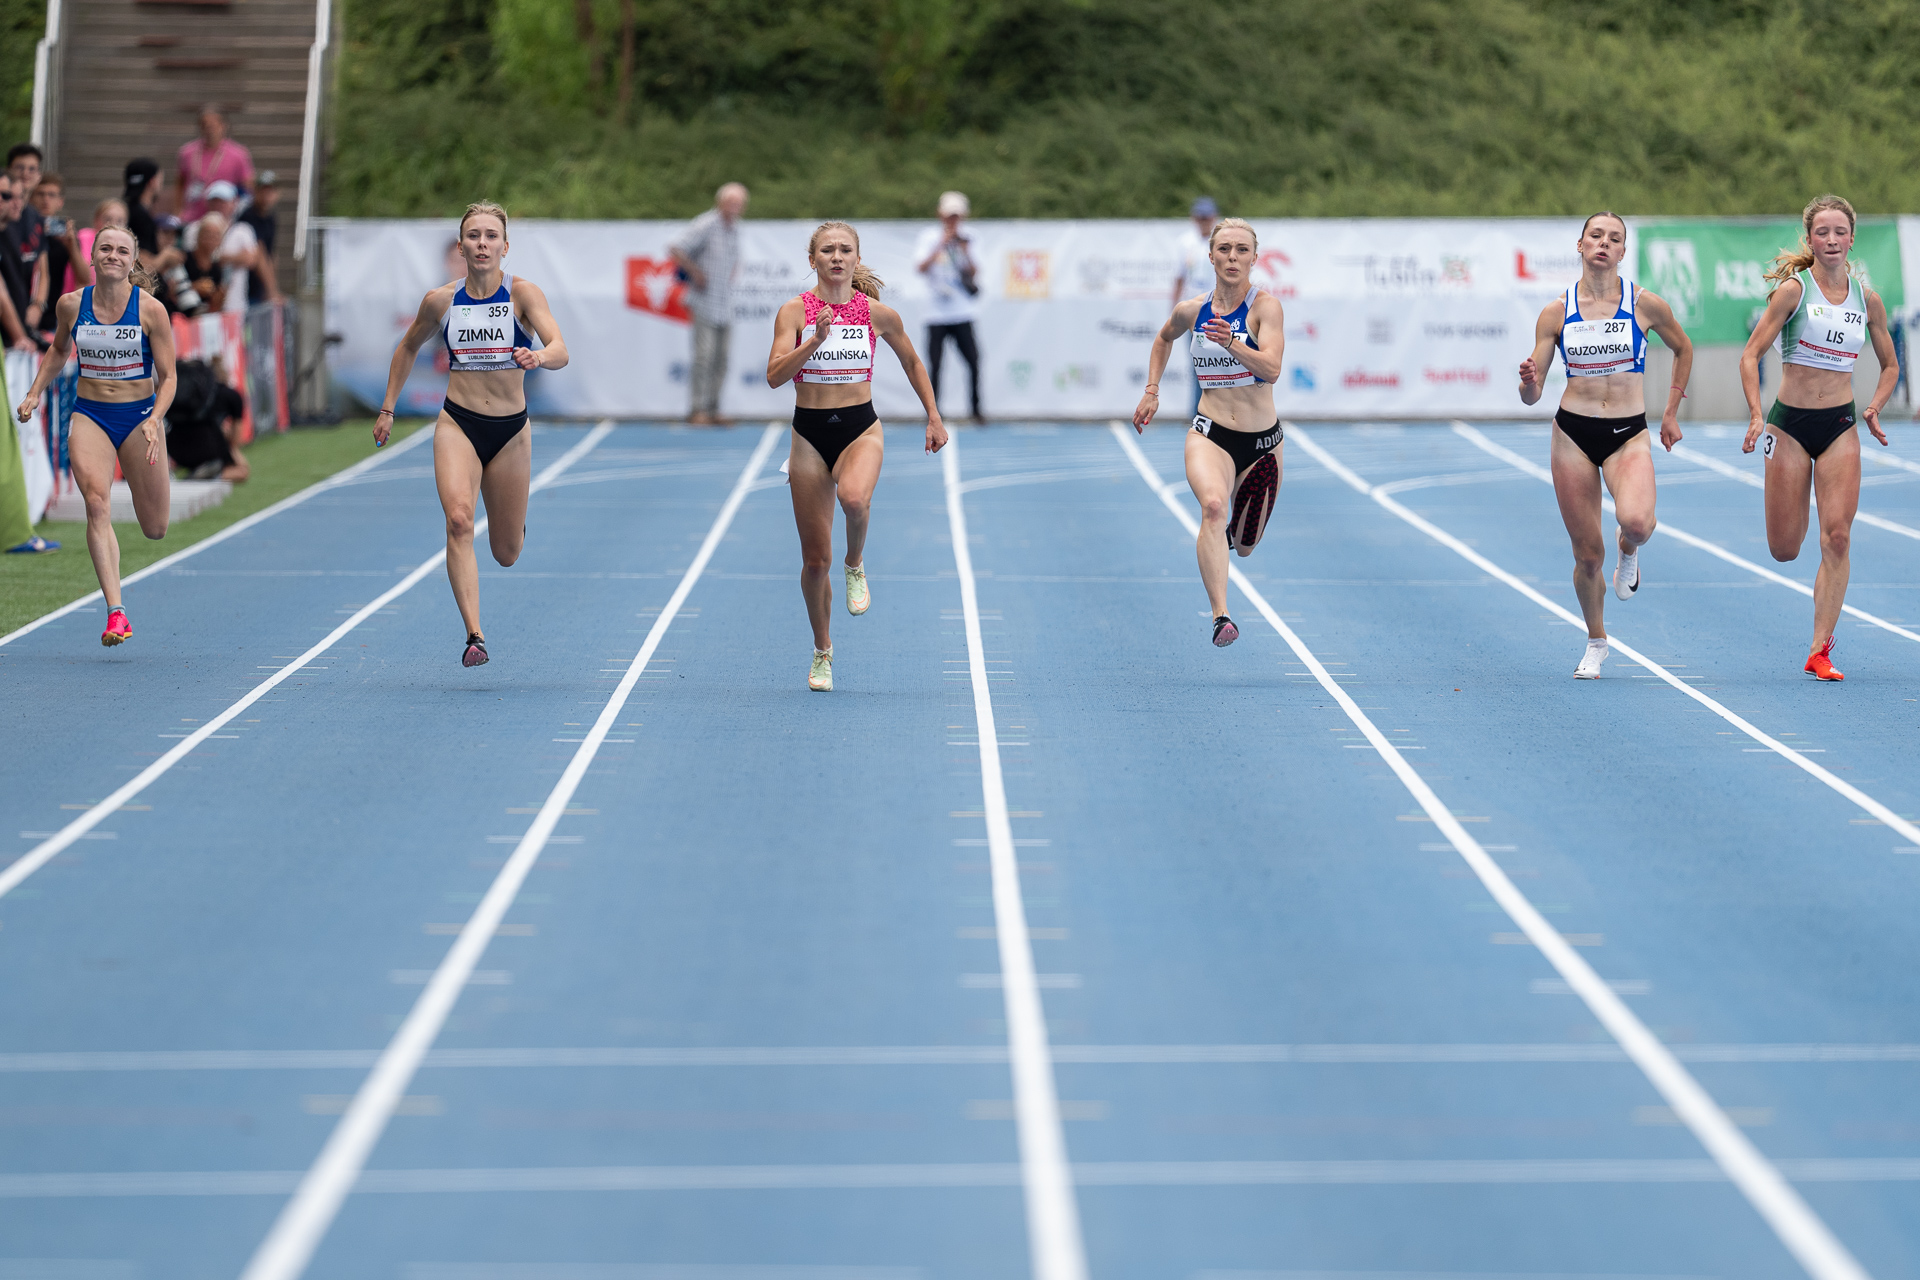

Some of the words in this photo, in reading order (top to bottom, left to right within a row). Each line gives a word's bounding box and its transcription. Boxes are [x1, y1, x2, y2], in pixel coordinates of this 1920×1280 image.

[488, 306, 508, 318] 359
[1844, 312, 1862, 326] 374
[842, 328, 864, 340] 223
[1604, 322, 1626, 334] 287
[115, 329, 136, 340] 250
[458, 328, 505, 342] ZIMNA
[1826, 330, 1845, 345] LIS
[80, 348, 139, 360] BELOWSKA
[808, 348, 868, 360] WOLIŃSKA
[1567, 343, 1631, 356] GUZOWSKA
[1193, 356, 1240, 367] DZIAMSK
[1195, 418, 1206, 433] 5
[1255, 424, 1283, 450] ADIDA
[1764, 435, 1773, 455] 3
